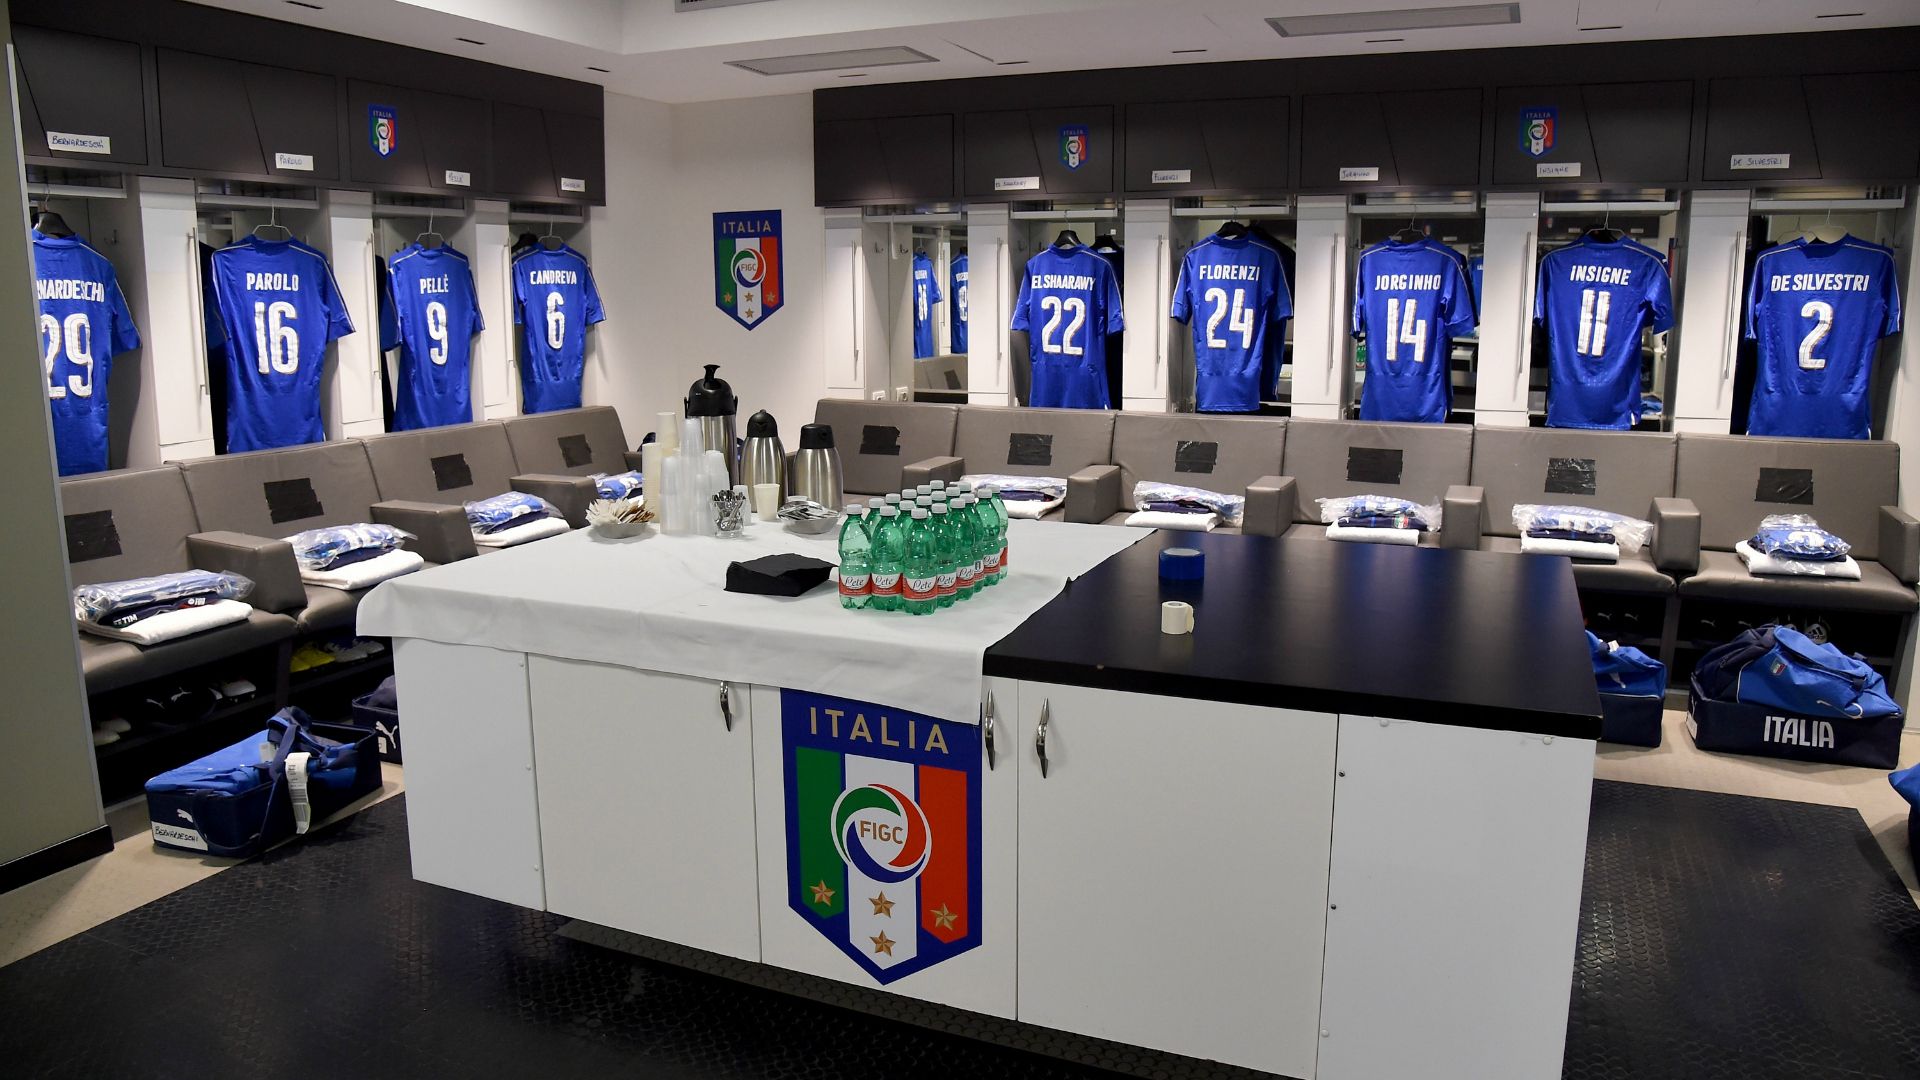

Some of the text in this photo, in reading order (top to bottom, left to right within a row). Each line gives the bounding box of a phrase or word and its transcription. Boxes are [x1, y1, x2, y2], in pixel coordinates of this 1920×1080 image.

[1526, 111, 1552, 119] ITALIA
[1539, 166, 1569, 174] INSIGNE
[722, 220, 772, 234] ITALIA
[530, 270, 577, 285] CANDREVA
[740, 263, 758, 272] FIGC
[1199, 264, 1260, 282] FLORENZI
[1569, 265, 1632, 286] INSIGNE
[246, 272, 299, 292] PAROLO
[1374, 274, 1442, 291] JORGINHO
[1771, 273, 1870, 292] DE SILVESTRI
[547, 291, 565, 349] 6
[1041, 295, 1086, 356] 22
[1204, 287, 1254, 350] 24
[1386, 298, 1427, 363] 14
[1577, 289, 1611, 356] 11
[254, 301, 299, 375] 16
[426, 301, 449, 365] 9
[1798, 301, 1833, 369] 2
[40, 312, 94, 399] 29
[122, 614, 138, 625] TIM
[810, 706, 949, 754] ITALIA
[1763, 715, 1835, 749] ITALIA
[859, 820, 904, 845] FIGC
